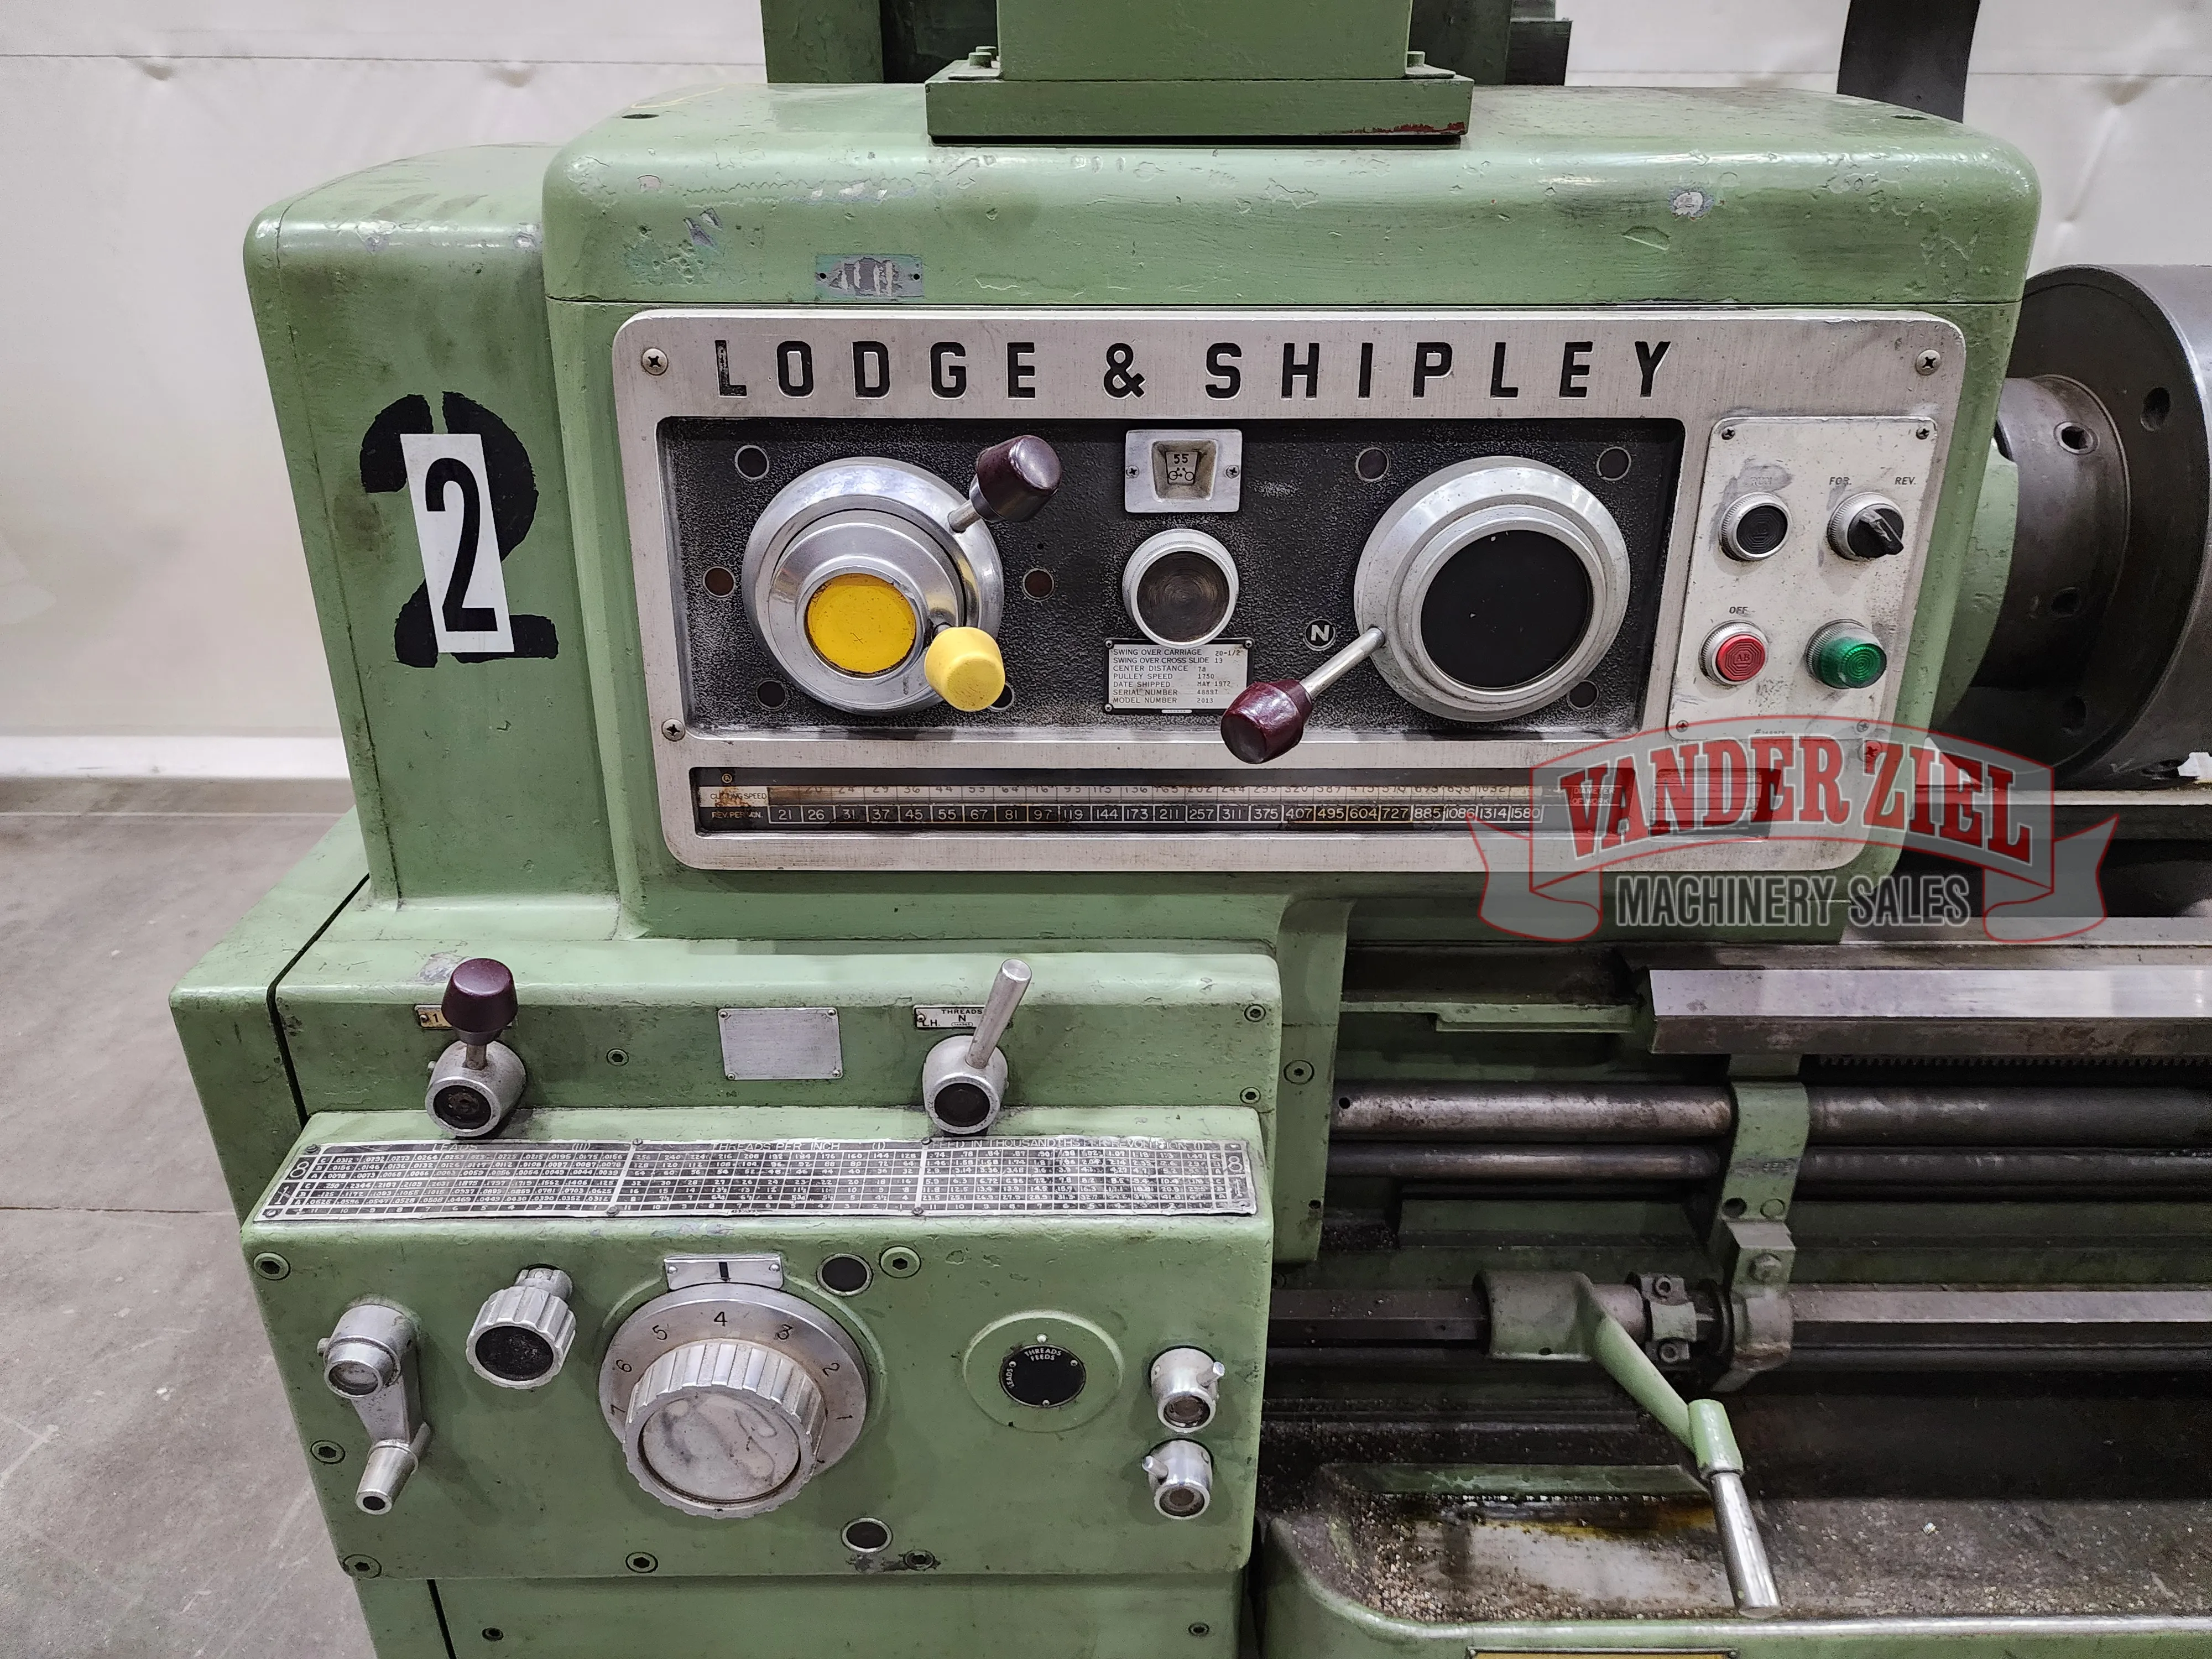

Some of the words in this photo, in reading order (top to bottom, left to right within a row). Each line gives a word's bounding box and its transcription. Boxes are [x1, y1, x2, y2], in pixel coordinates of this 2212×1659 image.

[714, 340, 1037, 400] LODGE
[1103, 342, 1146, 400] &
[1204, 341, 1671, 399] SHIPLEY
[1173, 454, 1188, 464] 55
[1895, 476, 1916, 486] REV.
[425, 458, 498, 632] 2
[1729, 606, 1748, 614] OFF
[1311, 624, 1329, 641] N
[779, 810, 792, 820] 21
[808, 809, 825, 820] 26
[842, 809, 855, 820] 31
[873, 809, 890, 820] 37
[905, 809, 923, 820] 45
[938, 809, 956, 820] 55
[971, 809, 988, 820] 67
[1005, 810, 1018, 820] 81
[1034, 810, 1052, 820] 97
[1064, 810, 1083, 820] 119
[1097, 809, 1118, 820] 144
[1127, 809, 1148, 820] 173
[1160, 809, 1178, 819] 211
[1190, 809, 1214, 819] 257
[1222, 808, 1241, 820] 311
[1254, 808, 1279, 820] 375
[1286, 808, 1312, 819] 407
[1318, 808, 1344, 819] 495
[1350, 808, 1377, 819] 604
[1383, 808, 1409, 818] 727
[1415, 808, 1441, 819] 885
[1446, 808, 1475, 818] 1086
[1480, 808, 1507, 818] 1314
[1511, 808, 1540, 818] 1580
[432, 1013, 439, 1022] 1
[713, 1311, 728, 1327] 4
[652, 1324, 667, 1340] 5
[776, 1324, 793, 1340] 3
[1024, 1348, 1062, 1356] THREADS
[615, 1359, 633, 1373] 6
[822, 1363, 841, 1376] 2
[1005, 1368, 1015, 1389] LEADS
[609, 1404, 626, 1416] 7
